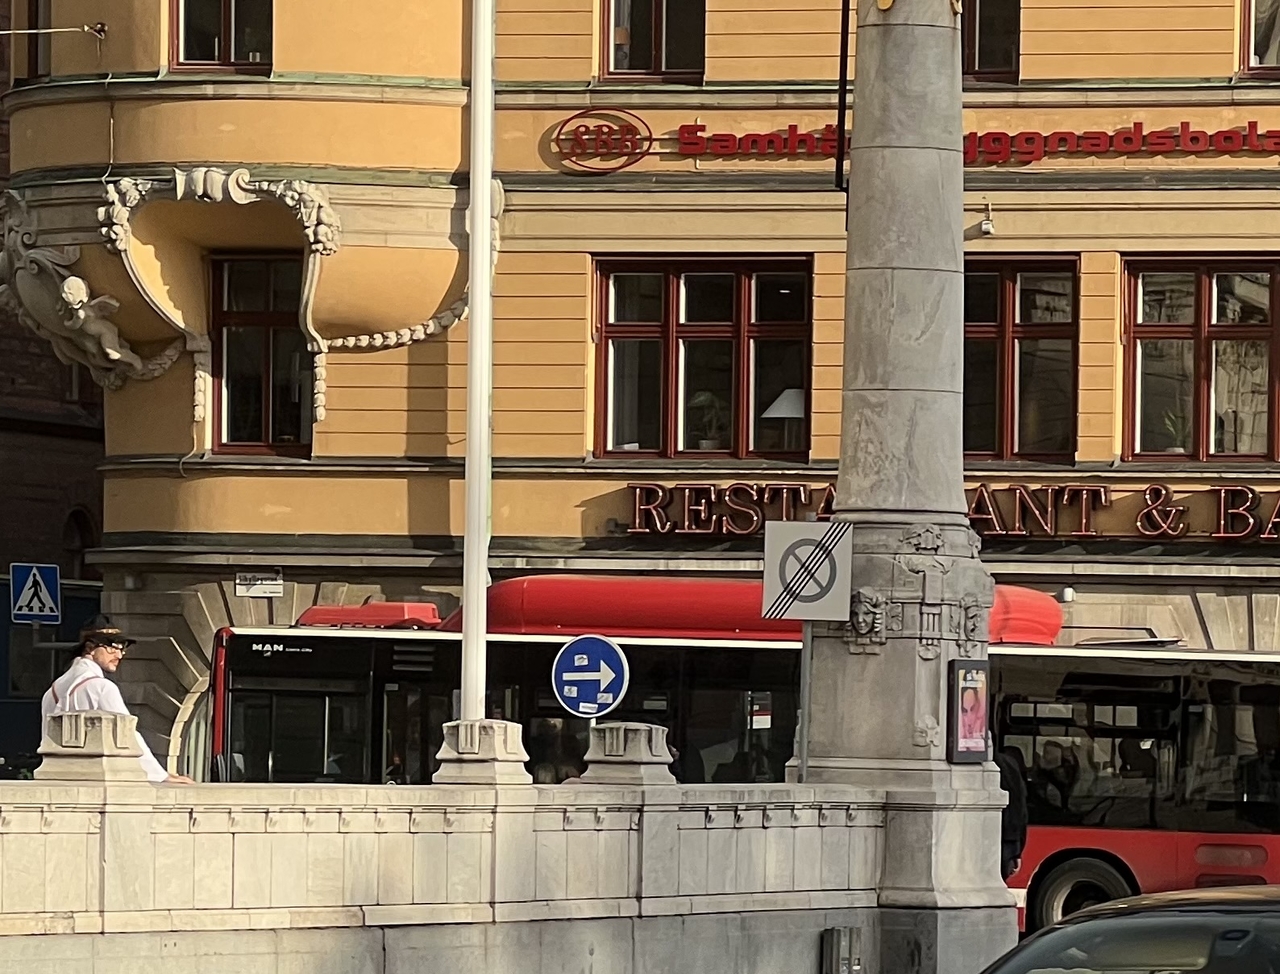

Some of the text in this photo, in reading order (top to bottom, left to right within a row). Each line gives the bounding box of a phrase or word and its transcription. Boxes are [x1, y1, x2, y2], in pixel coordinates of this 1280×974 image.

[570, 124, 639, 156] SBB
[1136, 484, 1188, 538] &
[252, 643, 284, 652] MAN
